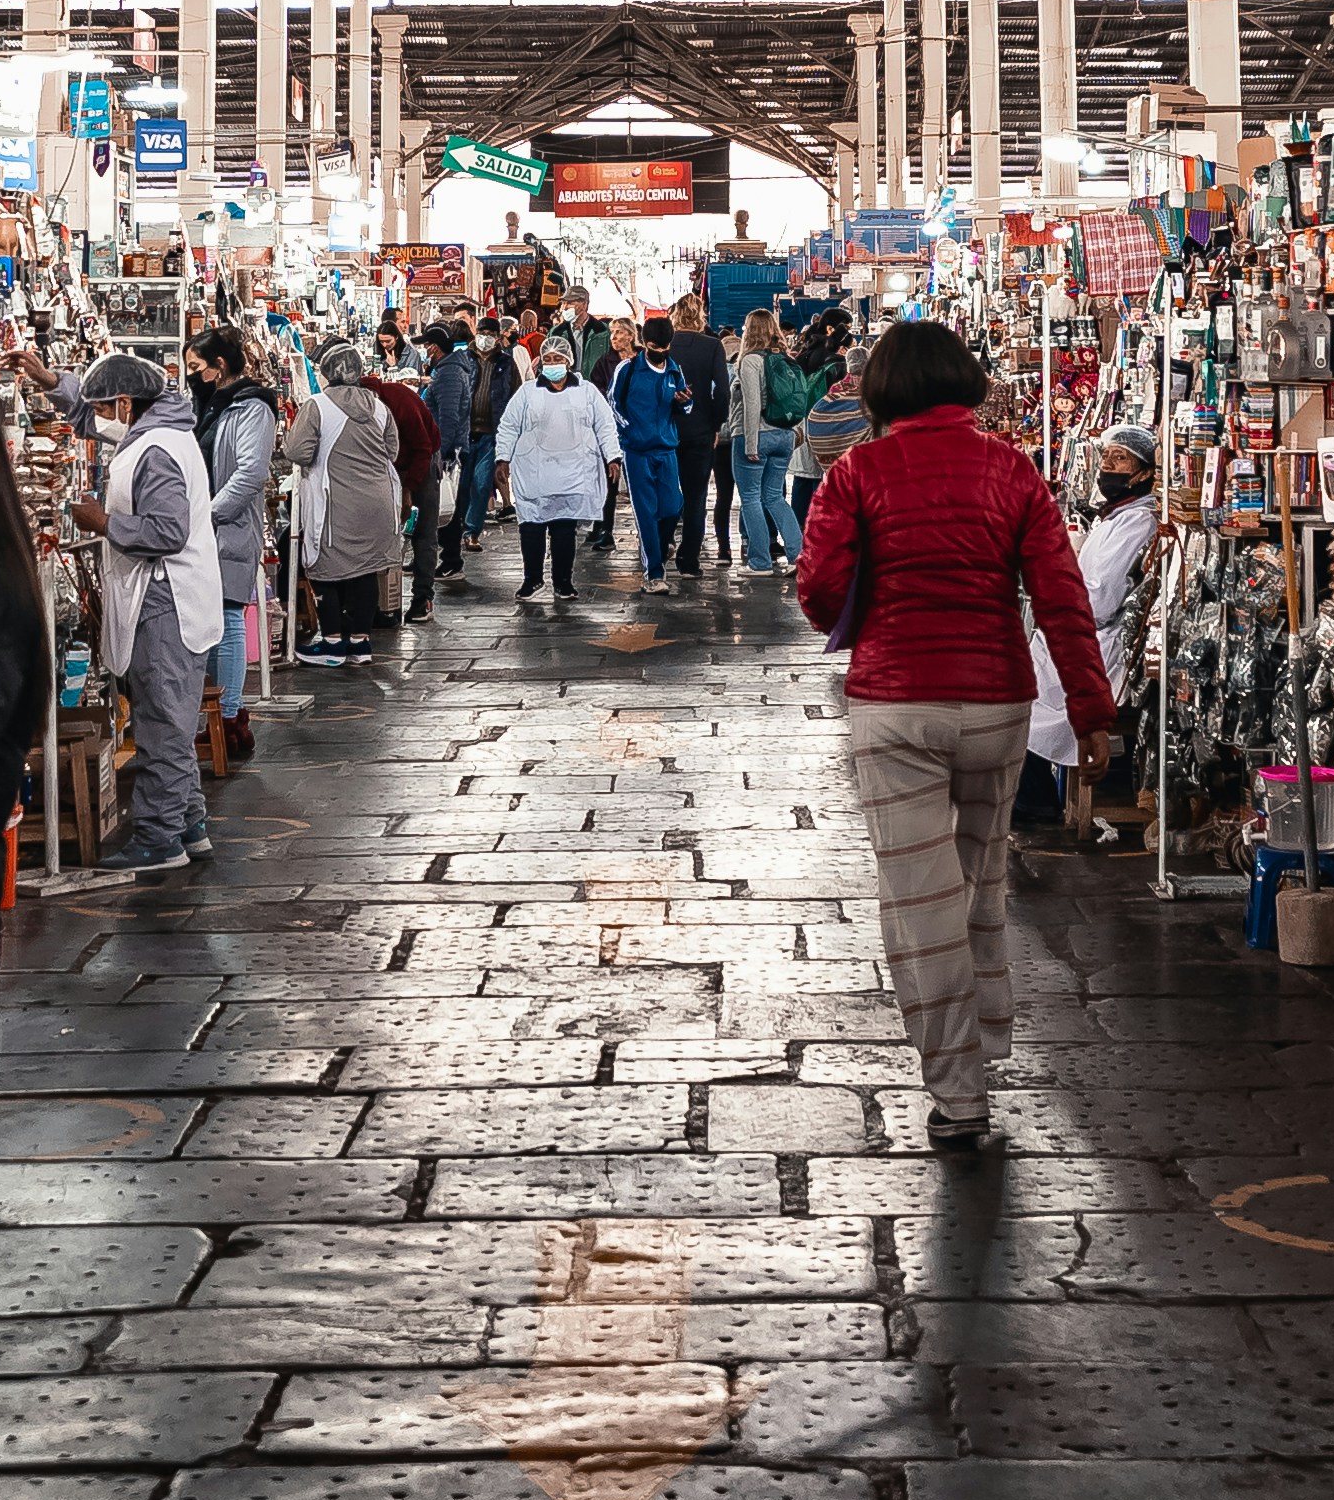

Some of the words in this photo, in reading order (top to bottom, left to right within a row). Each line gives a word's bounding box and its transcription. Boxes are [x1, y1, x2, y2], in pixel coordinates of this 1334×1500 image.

[140, 133, 183, 150] VISA
[323, 159, 346, 172] VISA
[475, 154, 532, 182] SALIDA
[558, 189, 613, 203] ABARROTES
[614, 189, 645, 202] PASEO
[646, 187, 689, 201] CENTRAL
